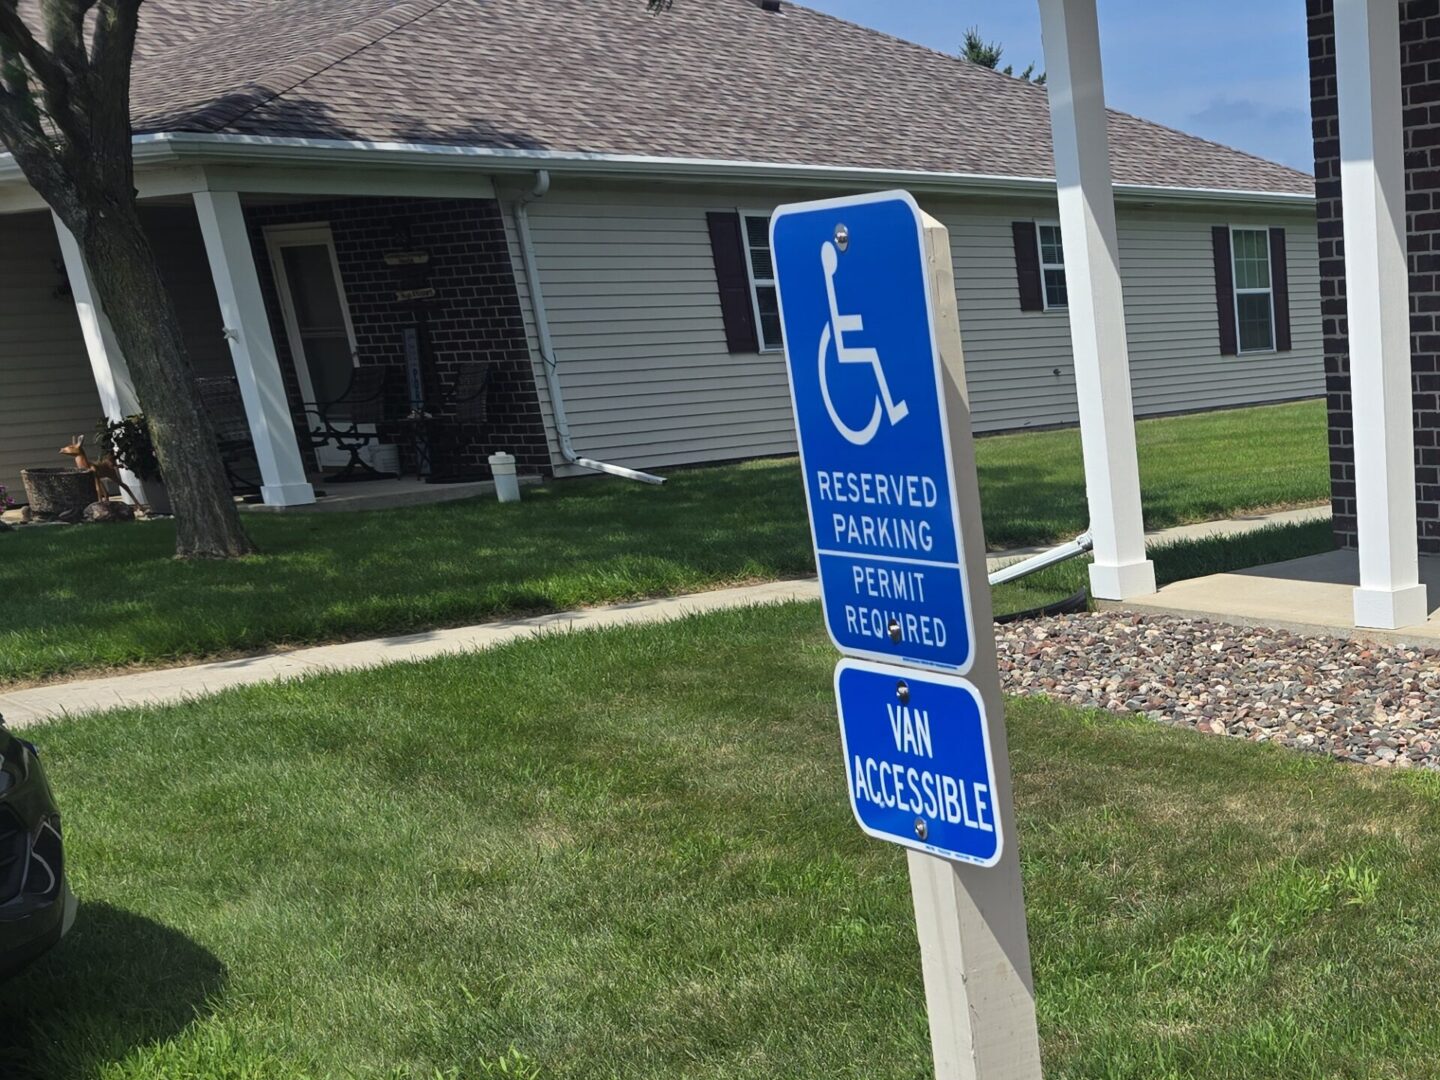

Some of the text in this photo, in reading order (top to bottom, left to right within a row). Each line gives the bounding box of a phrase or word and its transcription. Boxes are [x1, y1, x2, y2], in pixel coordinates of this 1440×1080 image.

[817, 471, 937, 508] RESERVED
[832, 513, 933, 551] PARKING
[852, 565, 924, 602] PERMIT
[887, 703, 933, 759] VAN
[854, 755, 993, 832] ACCESSIBLE
